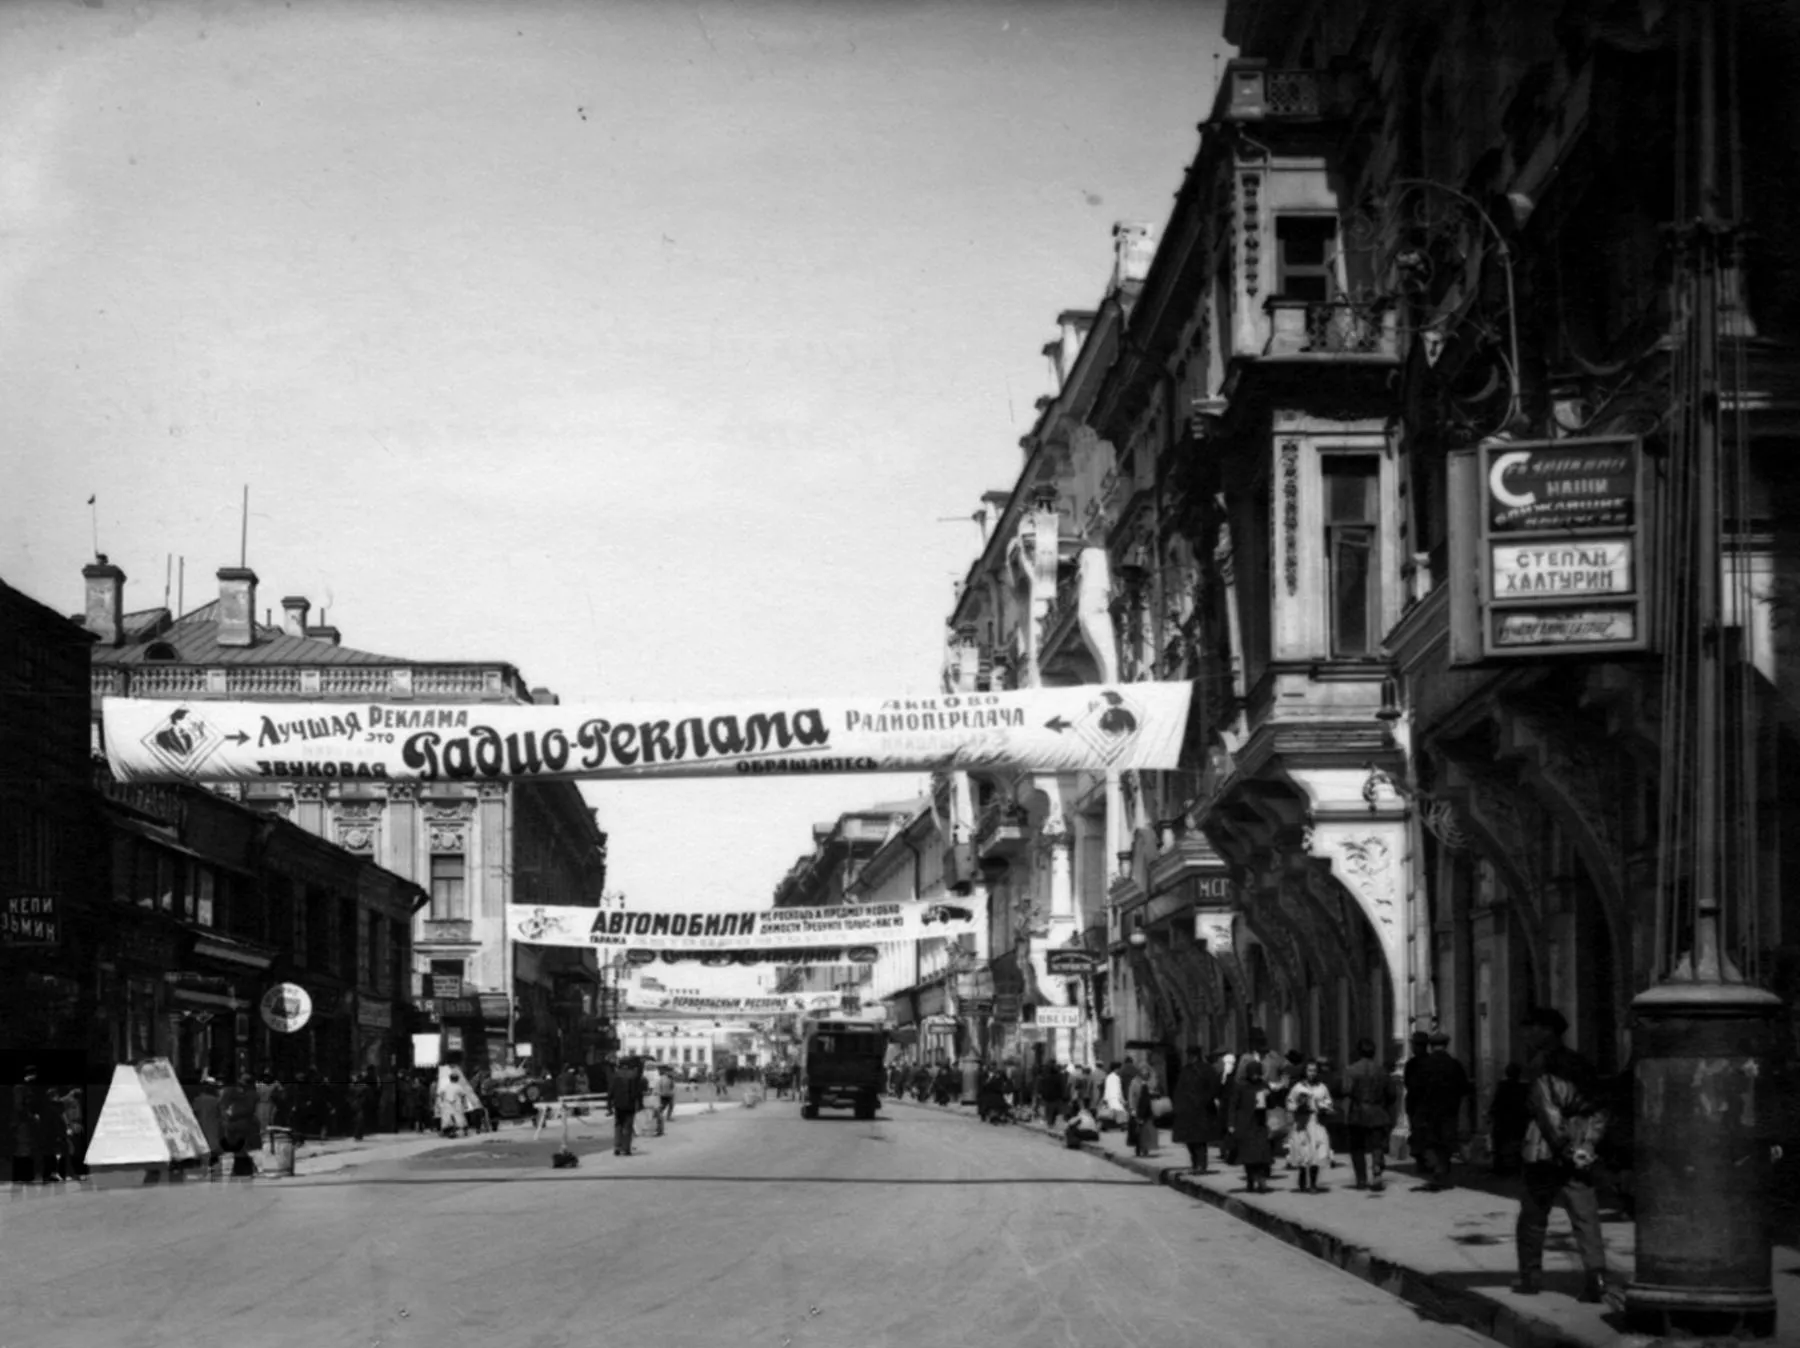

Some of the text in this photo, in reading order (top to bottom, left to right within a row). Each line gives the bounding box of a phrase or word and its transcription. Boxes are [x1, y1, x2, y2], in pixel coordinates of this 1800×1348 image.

[1516, 550, 1607, 569] СТЕПАН
[1505, 569, 1614, 591] ХАЛТУРИН
[257, 704, 469, 749] ЛУЧШАЯ РЕКЛАМА
[845, 707, 1025, 733] РАДИОПЕРЕДАЧА
[364, 732, 395, 744] ЭТО
[256, 760, 387, 778] ЗВУКОВАЯ
[590, 910, 756, 936] АВТОМОБИЛИ
